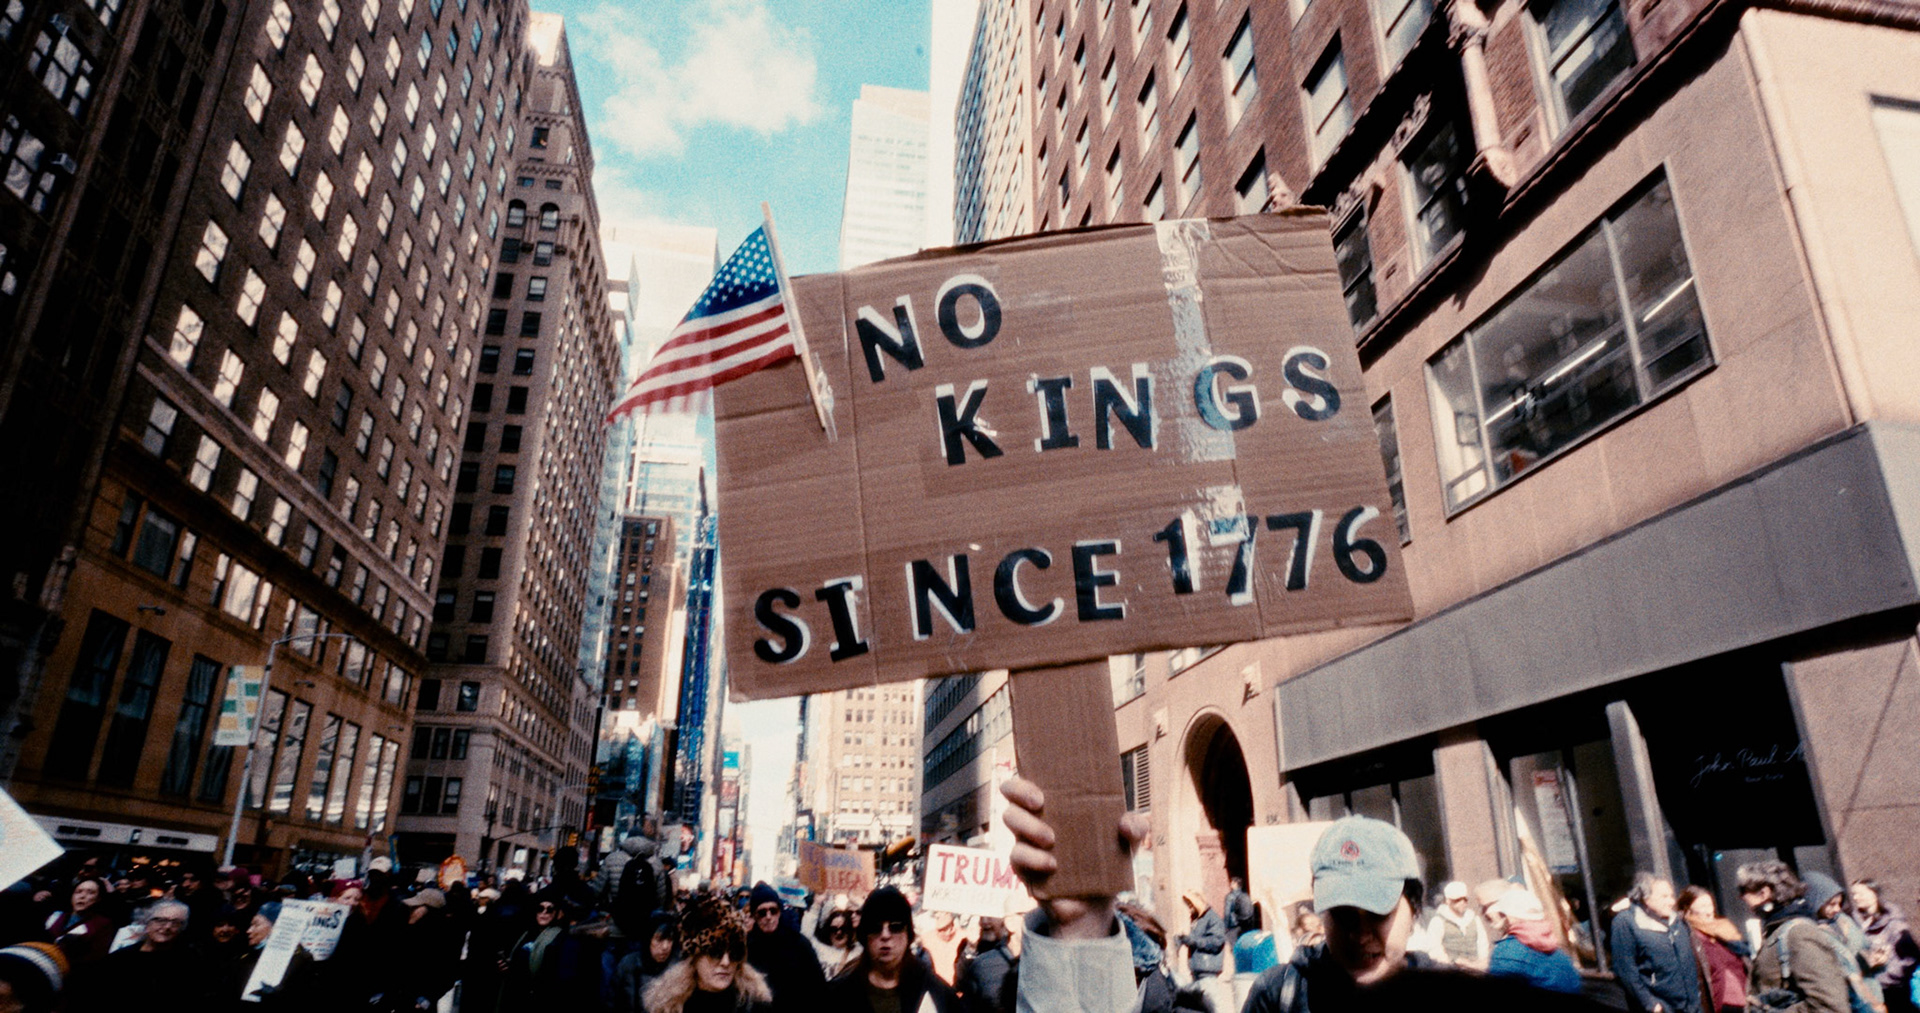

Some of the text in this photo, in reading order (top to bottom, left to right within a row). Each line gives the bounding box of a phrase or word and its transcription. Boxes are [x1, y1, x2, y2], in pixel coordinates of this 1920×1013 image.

[854, 274, 1002, 383] NO
[935, 346, 1342, 466] KINGS
[753, 505, 1389, 664] SINCE 1776
[1736, 744, 1778, 769] Paul
[937, 852, 1021, 891] TRUM
